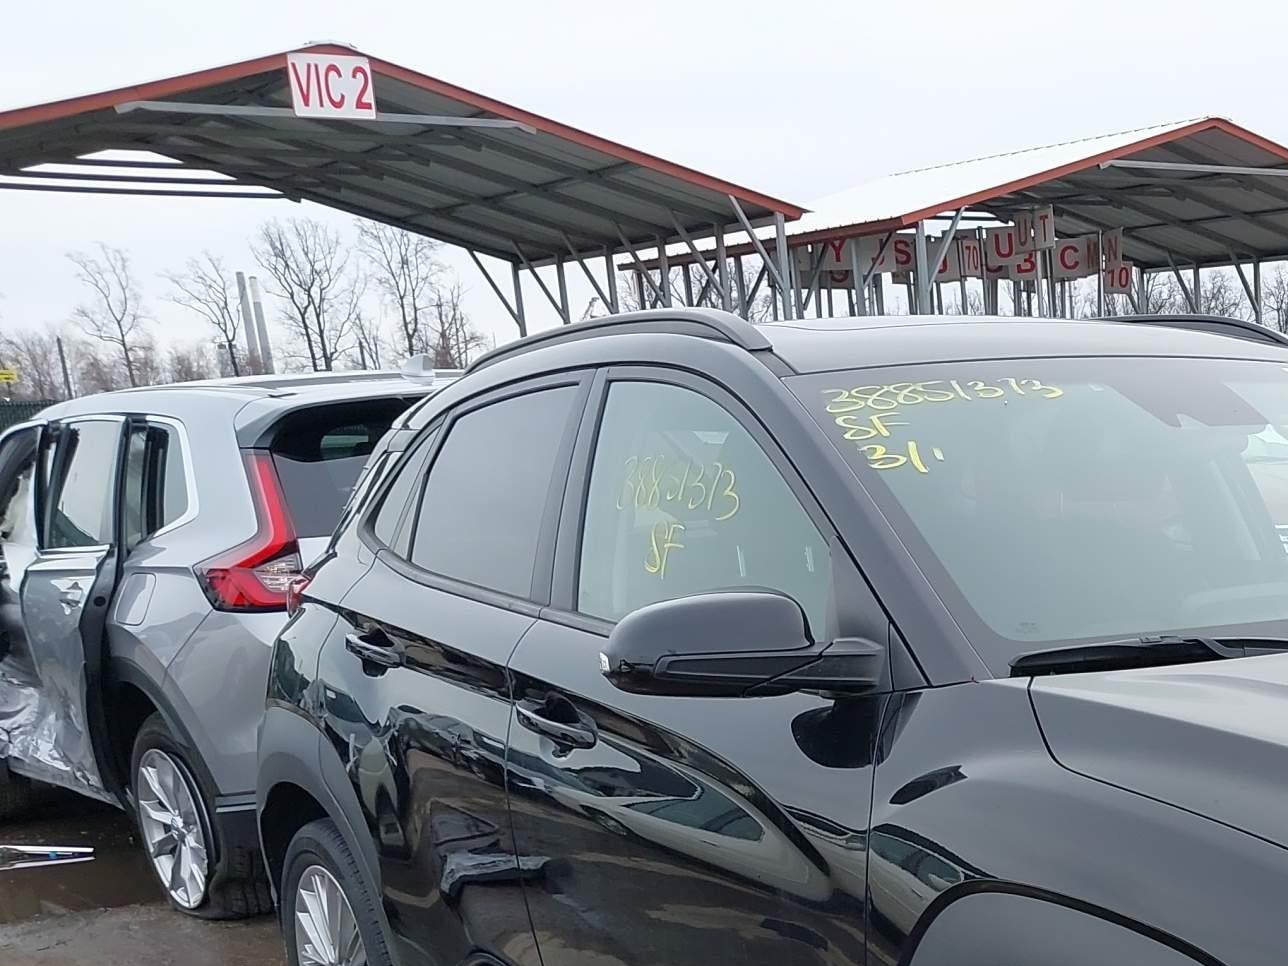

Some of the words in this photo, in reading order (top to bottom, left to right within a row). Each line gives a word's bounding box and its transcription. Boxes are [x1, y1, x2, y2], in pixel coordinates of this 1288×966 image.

[291, 62, 346, 109] VIC
[352, 66, 373, 110] 2
[1017, 218, 1028, 247] U
[1039, 214, 1049, 242] T
[830, 237, 846, 262] Y
[894, 239, 911, 265] S
[994, 232, 1013, 258] U
[1060, 245, 1080, 270] C
[1107, 267, 1129, 288] 10
[821, 377, 1065, 414] 38851373
